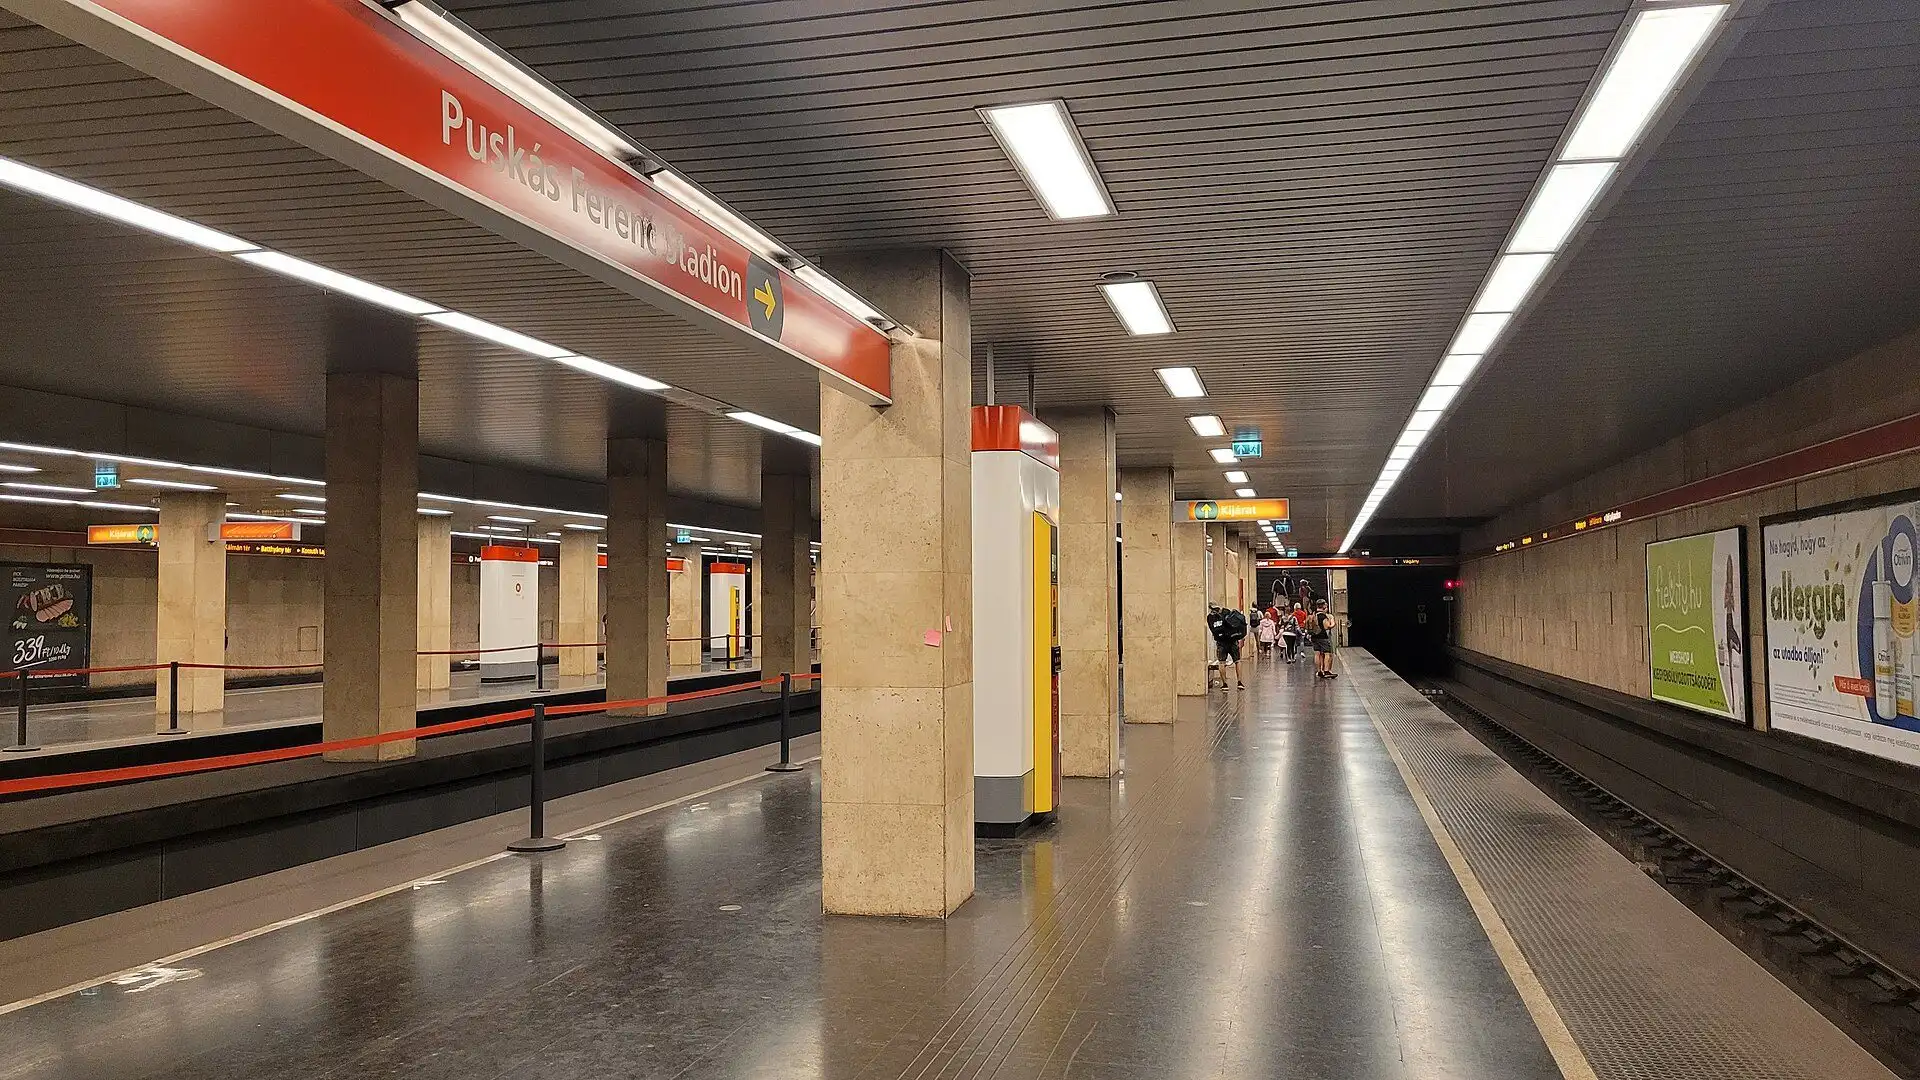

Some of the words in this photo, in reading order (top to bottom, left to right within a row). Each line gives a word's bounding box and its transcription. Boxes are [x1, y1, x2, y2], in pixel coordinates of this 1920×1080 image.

[441, 89, 560, 201] Puskás
[571, 166, 658, 257] Ferenc
[665, 224, 742, 301] Stadion
[1220, 505, 1256, 517] Kijárat
[261, 545, 284, 554] Batthyány
[1769, 540, 1778, 554] Ne
[1779, 537, 1799, 557] hogyd,
[1800, 536, 1816, 555] hogy
[1817, 537, 1826, 548] az
[1893, 553, 1911, 566] Otrivin
[1770, 569, 1846, 640] allergia
[13, 635, 45, 664] 339
[1773, 648, 1780, 659] az
[1781, 647, 1803, 662] utadba
